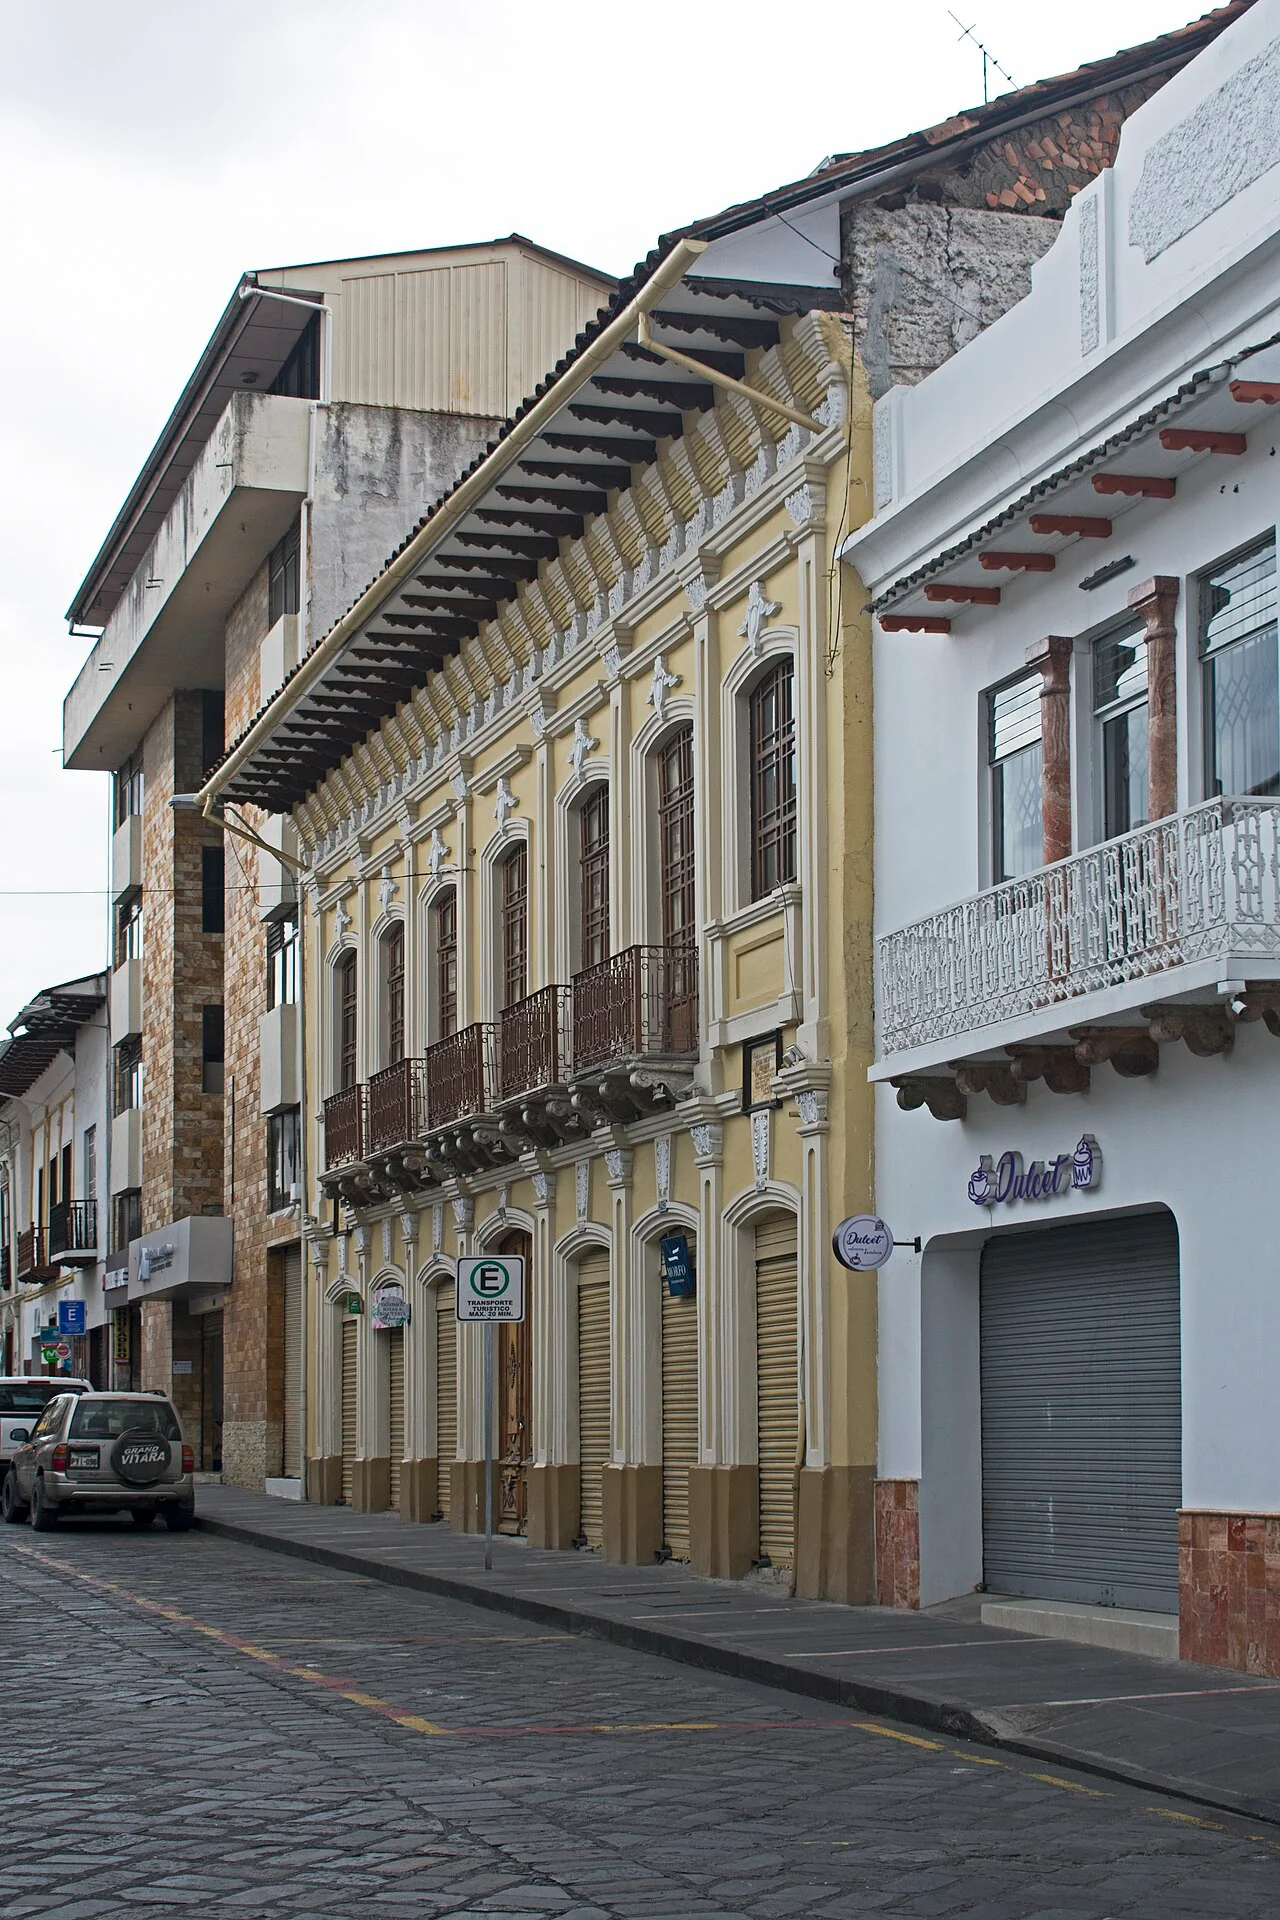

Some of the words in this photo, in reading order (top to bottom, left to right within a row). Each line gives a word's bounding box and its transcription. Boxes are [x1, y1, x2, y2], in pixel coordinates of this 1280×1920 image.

[995, 1151, 1069, 1203] Dulcet
[846, 1231, 885, 1245] Dulcet
[480, 1267, 500, 1291] E
[68, 1309, 77, 1321] E
[124, 1445, 159, 1455] GRAND
[121, 1451, 165, 1465] VITARA
